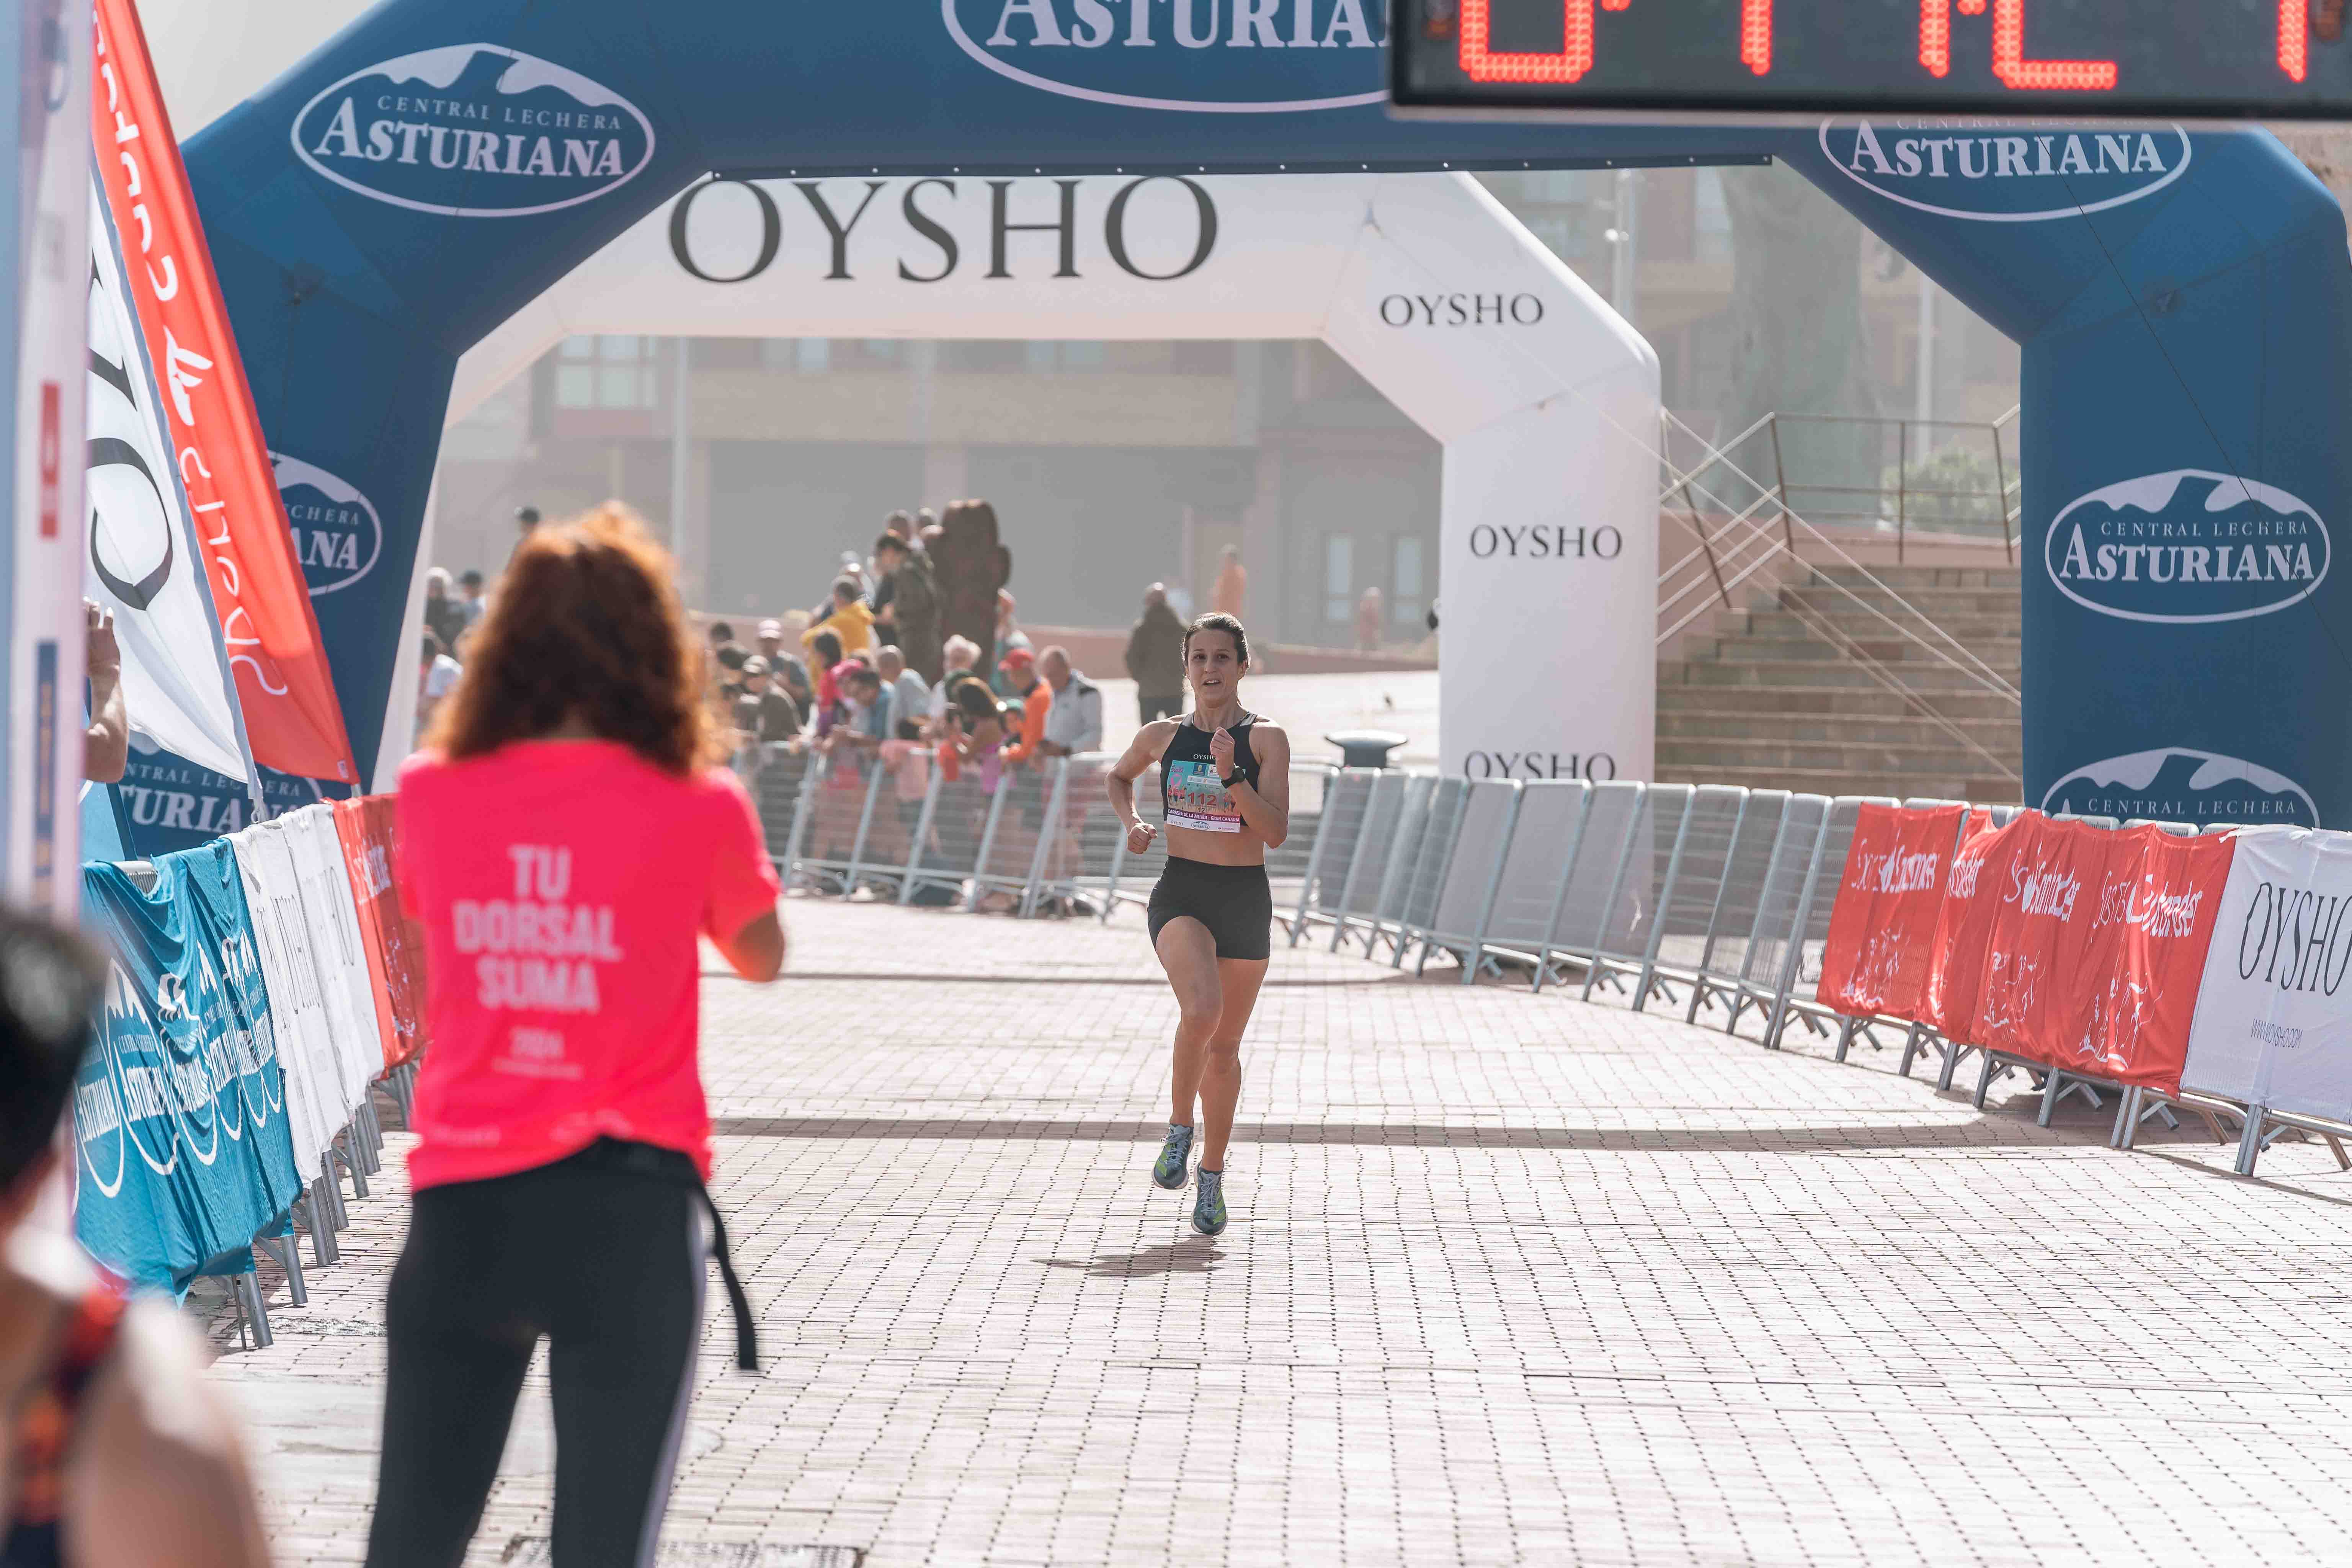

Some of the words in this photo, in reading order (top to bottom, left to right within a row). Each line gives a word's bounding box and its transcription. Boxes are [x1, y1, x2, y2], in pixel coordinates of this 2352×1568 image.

[986, 0, 1391, 48] ASTURIA
[377, 95, 490, 120] CENTRAL
[504, 107, 621, 130] LECHERA
[312, 96, 624, 177] ASTURIANA
[1850, 119, 2167, 178] ASTURIANA
[668, 175, 1218, 284] OYSHO
[1380, 293, 1545, 327] OYSHO
[284, 504, 359, 526] CHERA
[2100, 520, 2201, 537] CENTRAL
[2213, 520, 2307, 537] LECHERA
[1470, 524, 1623, 560] OYSHO
[2060, 523, 2314, 583] ASTURIANA
[125, 764, 191, 785] NTRAL
[203, 774, 301, 797] LECERA
[1463, 750, 1616, 781] OYSHO
[1188, 792, 1216, 806] 112
[2088, 798, 2185, 815] CENTRAL
[2197, 798, 2295, 815] LECHERA
[508, 844, 572, 900] TU
[452, 900, 624, 962] DORSAL
[2239, 882, 2352, 996] OYSHO
[477, 954, 601, 1015] SUMA
